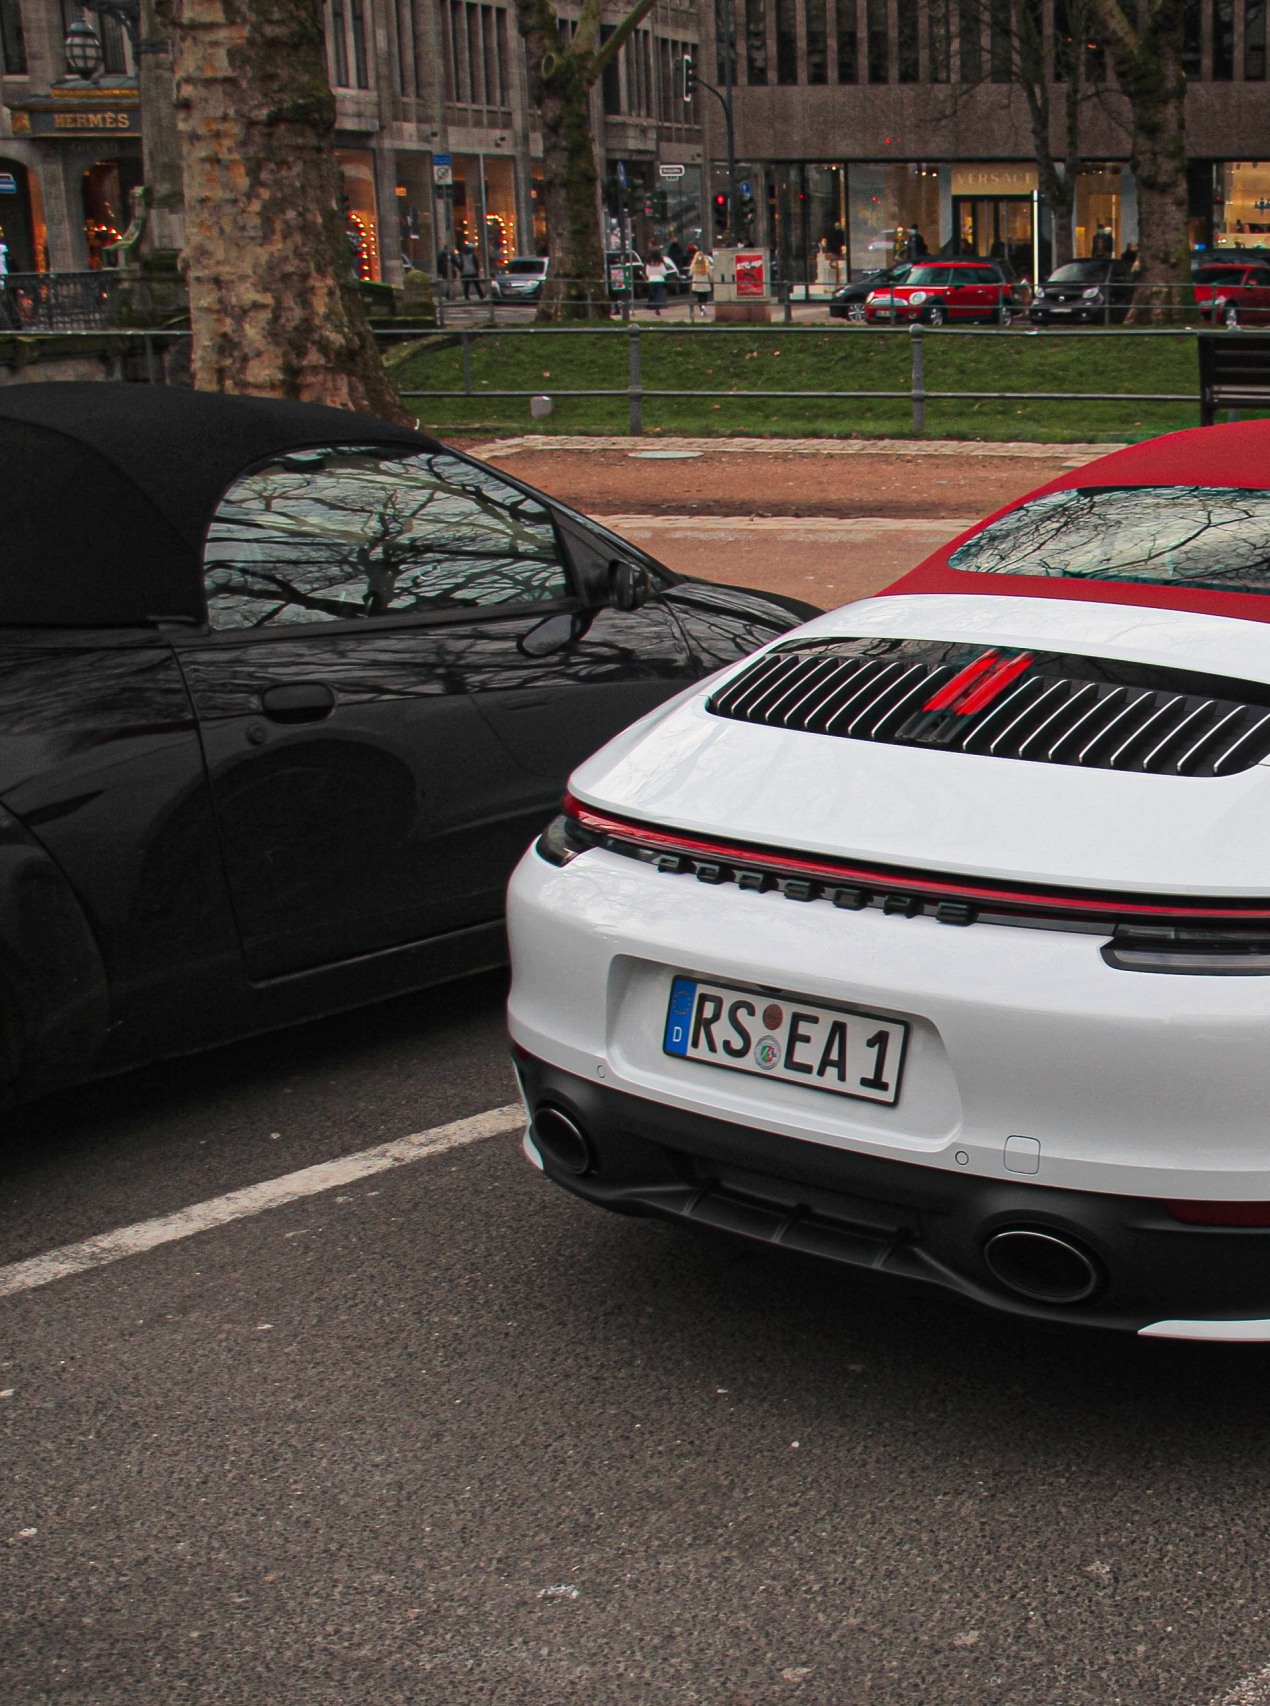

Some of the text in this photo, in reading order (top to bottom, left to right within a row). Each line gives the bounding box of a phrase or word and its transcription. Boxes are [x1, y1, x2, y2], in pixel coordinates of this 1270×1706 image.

[53, 111, 130, 128] HERMÈS
[672, 1026, 682, 1043] D
[690, 992, 890, 1092] RS EA 1
